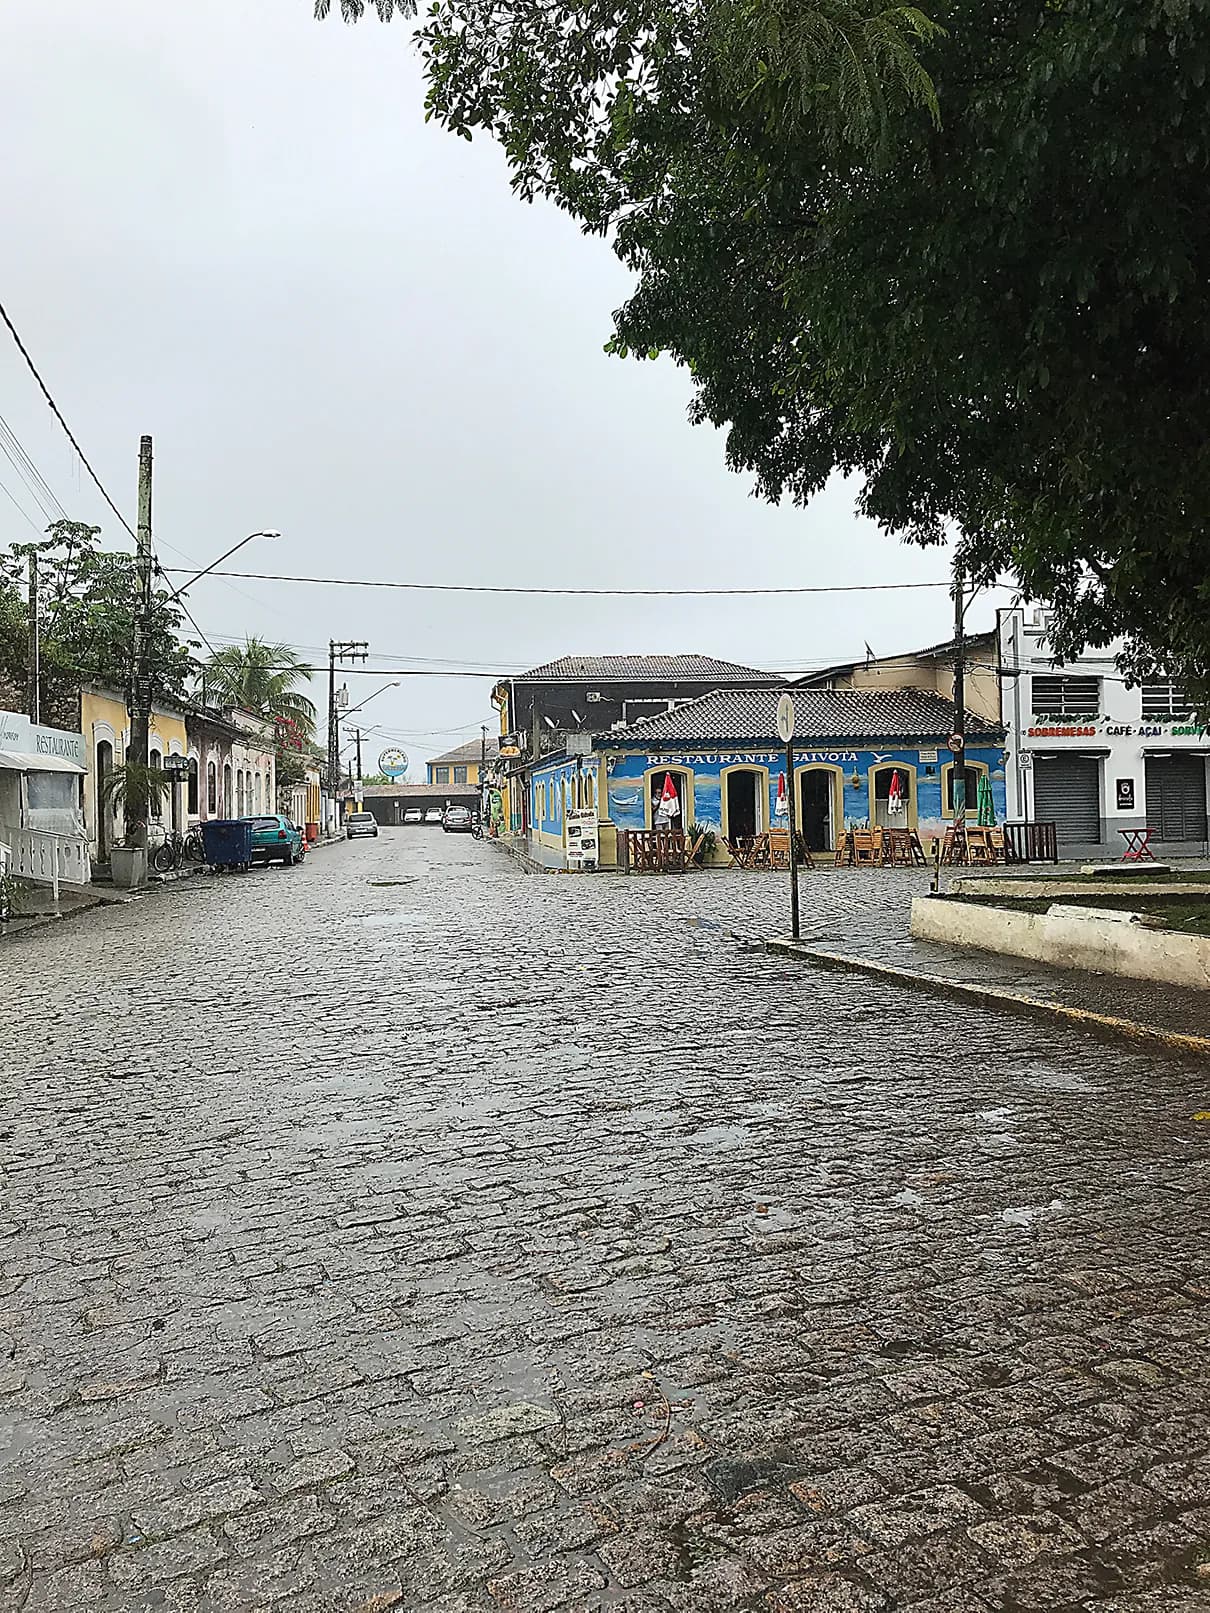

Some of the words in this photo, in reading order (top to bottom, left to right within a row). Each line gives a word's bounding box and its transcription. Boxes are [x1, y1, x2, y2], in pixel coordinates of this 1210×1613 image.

[1027, 726, 1096, 737] SOBREMESAS
[1106, 725, 1132, 736] CAFÉ
[1171, 725, 1205, 736] SORVE
[36, 734, 79, 758] RESTAURANTE
[646, 753, 779, 765] RESTAURANTE
[792, 752, 858, 762] GAIVOTA
